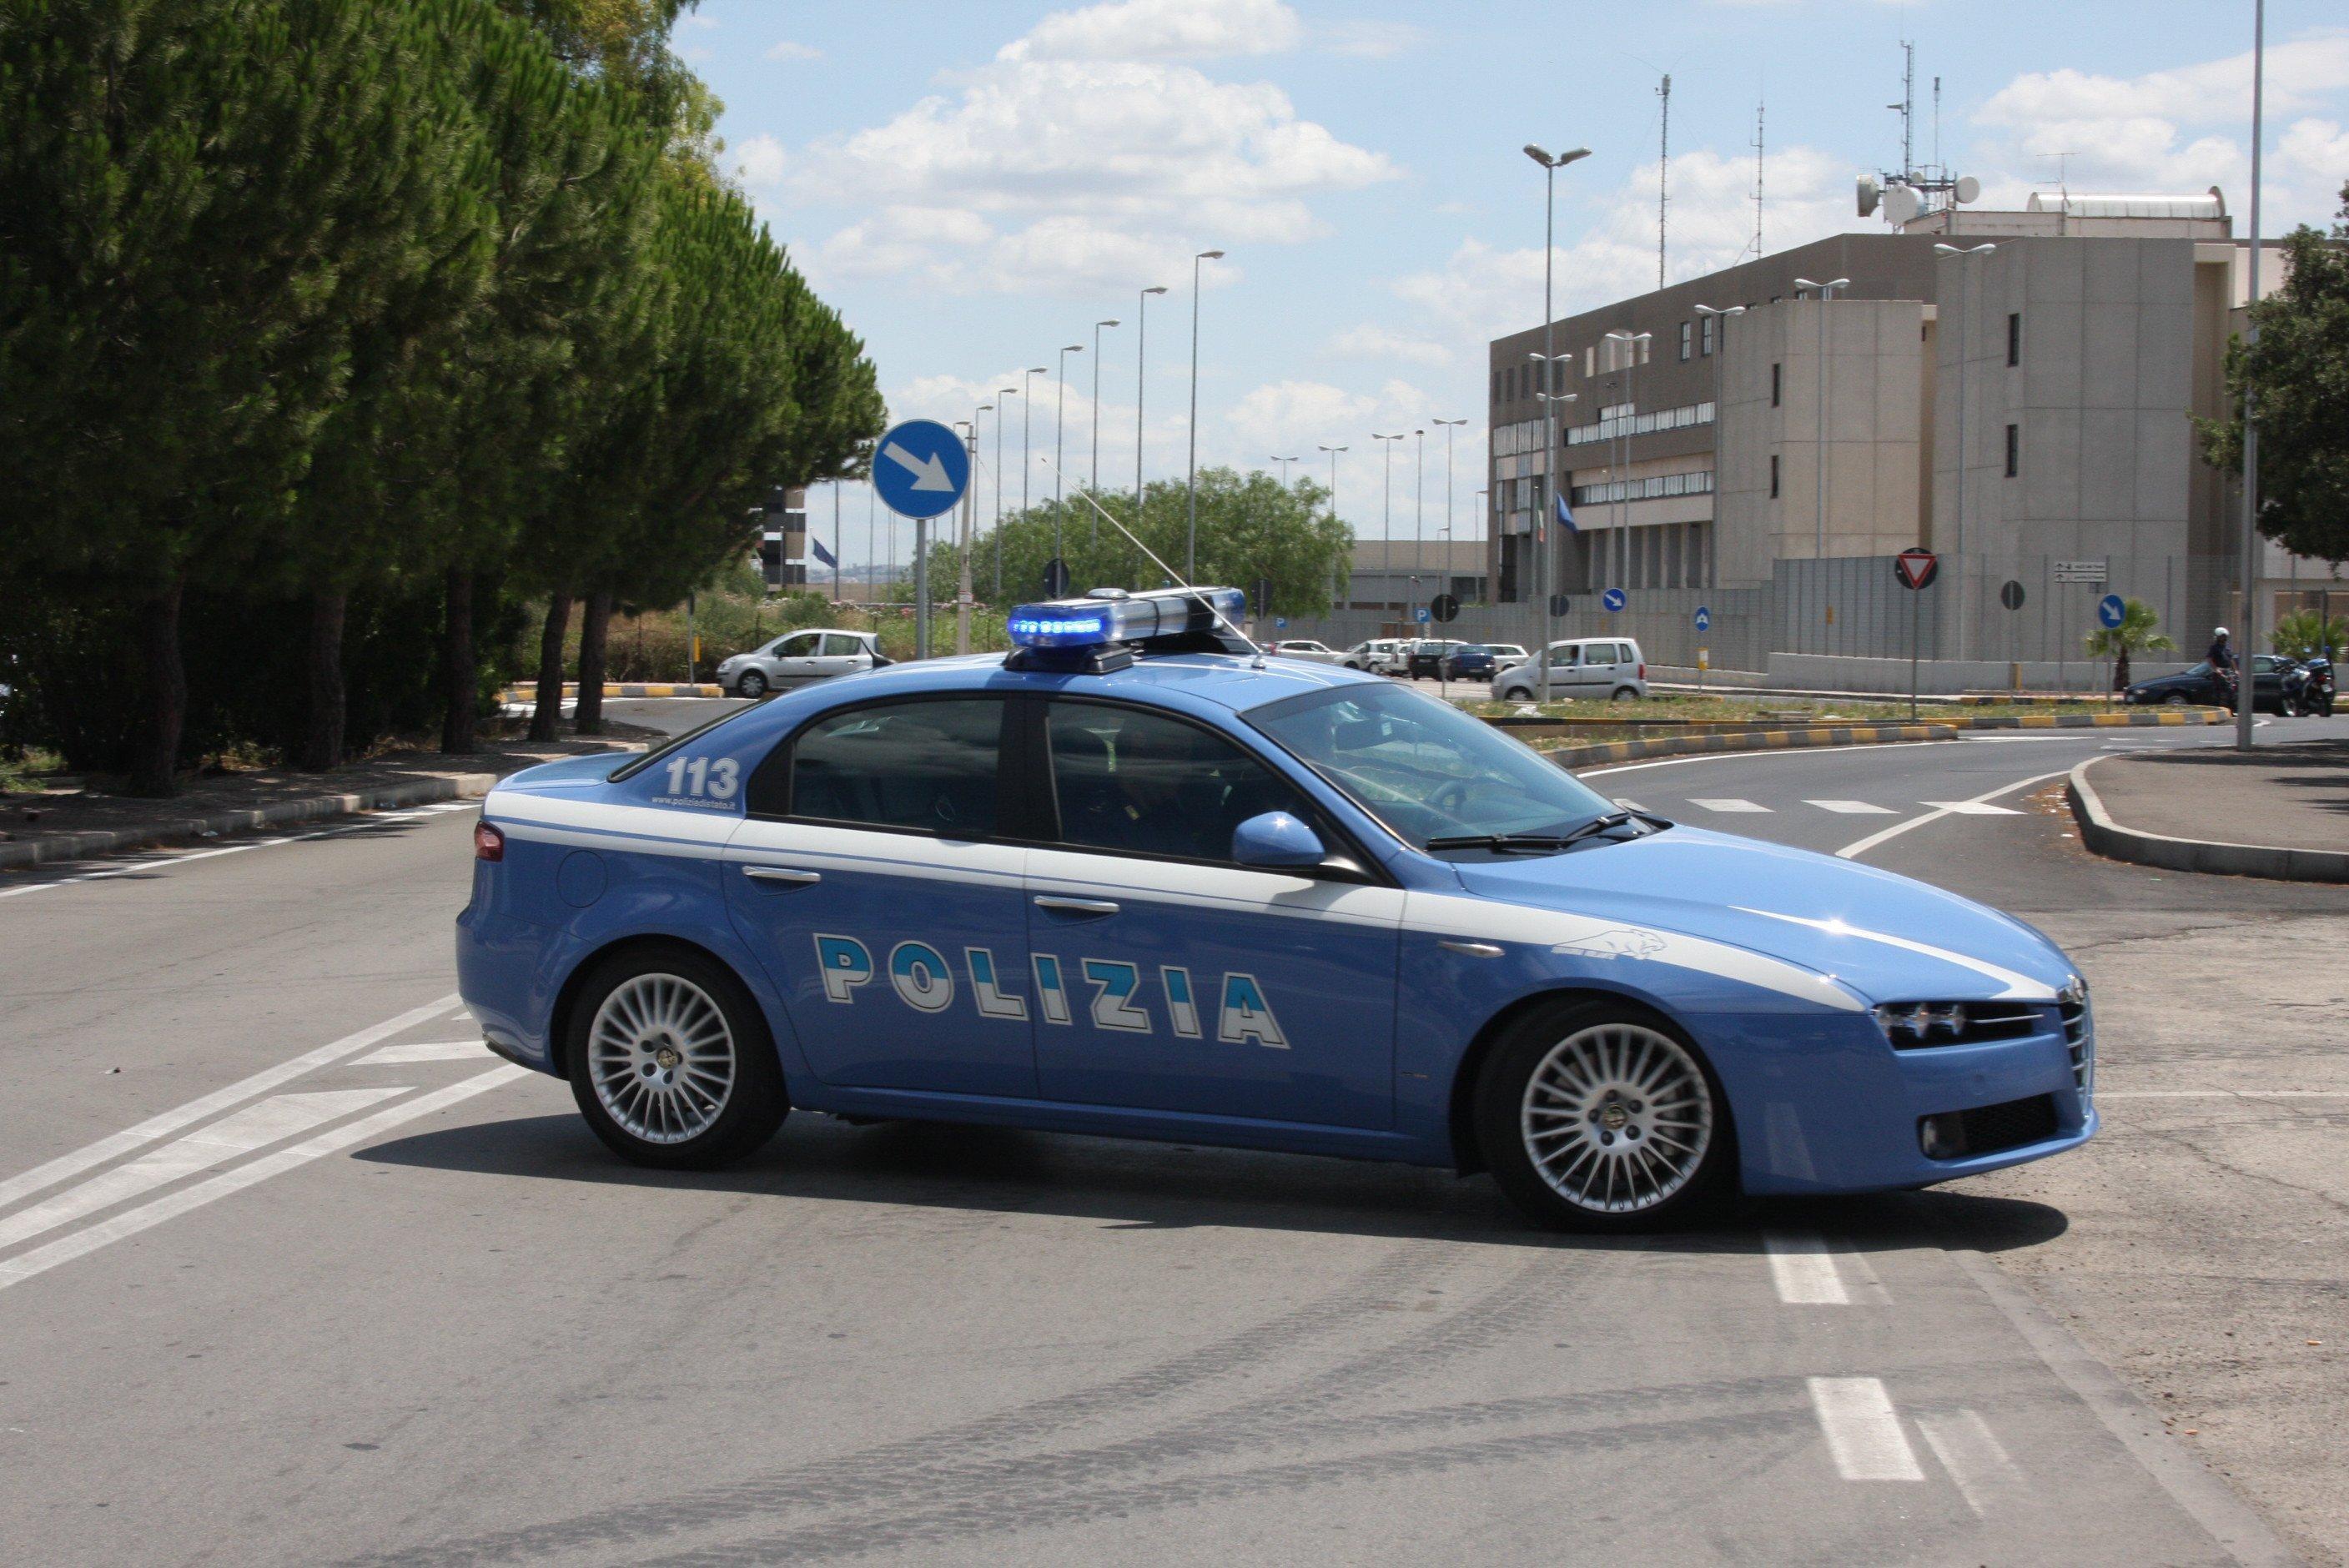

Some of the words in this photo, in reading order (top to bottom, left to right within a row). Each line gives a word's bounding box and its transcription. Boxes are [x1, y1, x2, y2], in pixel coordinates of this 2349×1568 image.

[1276, 617, 1285, 627] P
[1418, 610, 1426, 621] P
[666, 756, 740, 799] 113
[813, 932, 1291, 1049] POLIZIA
